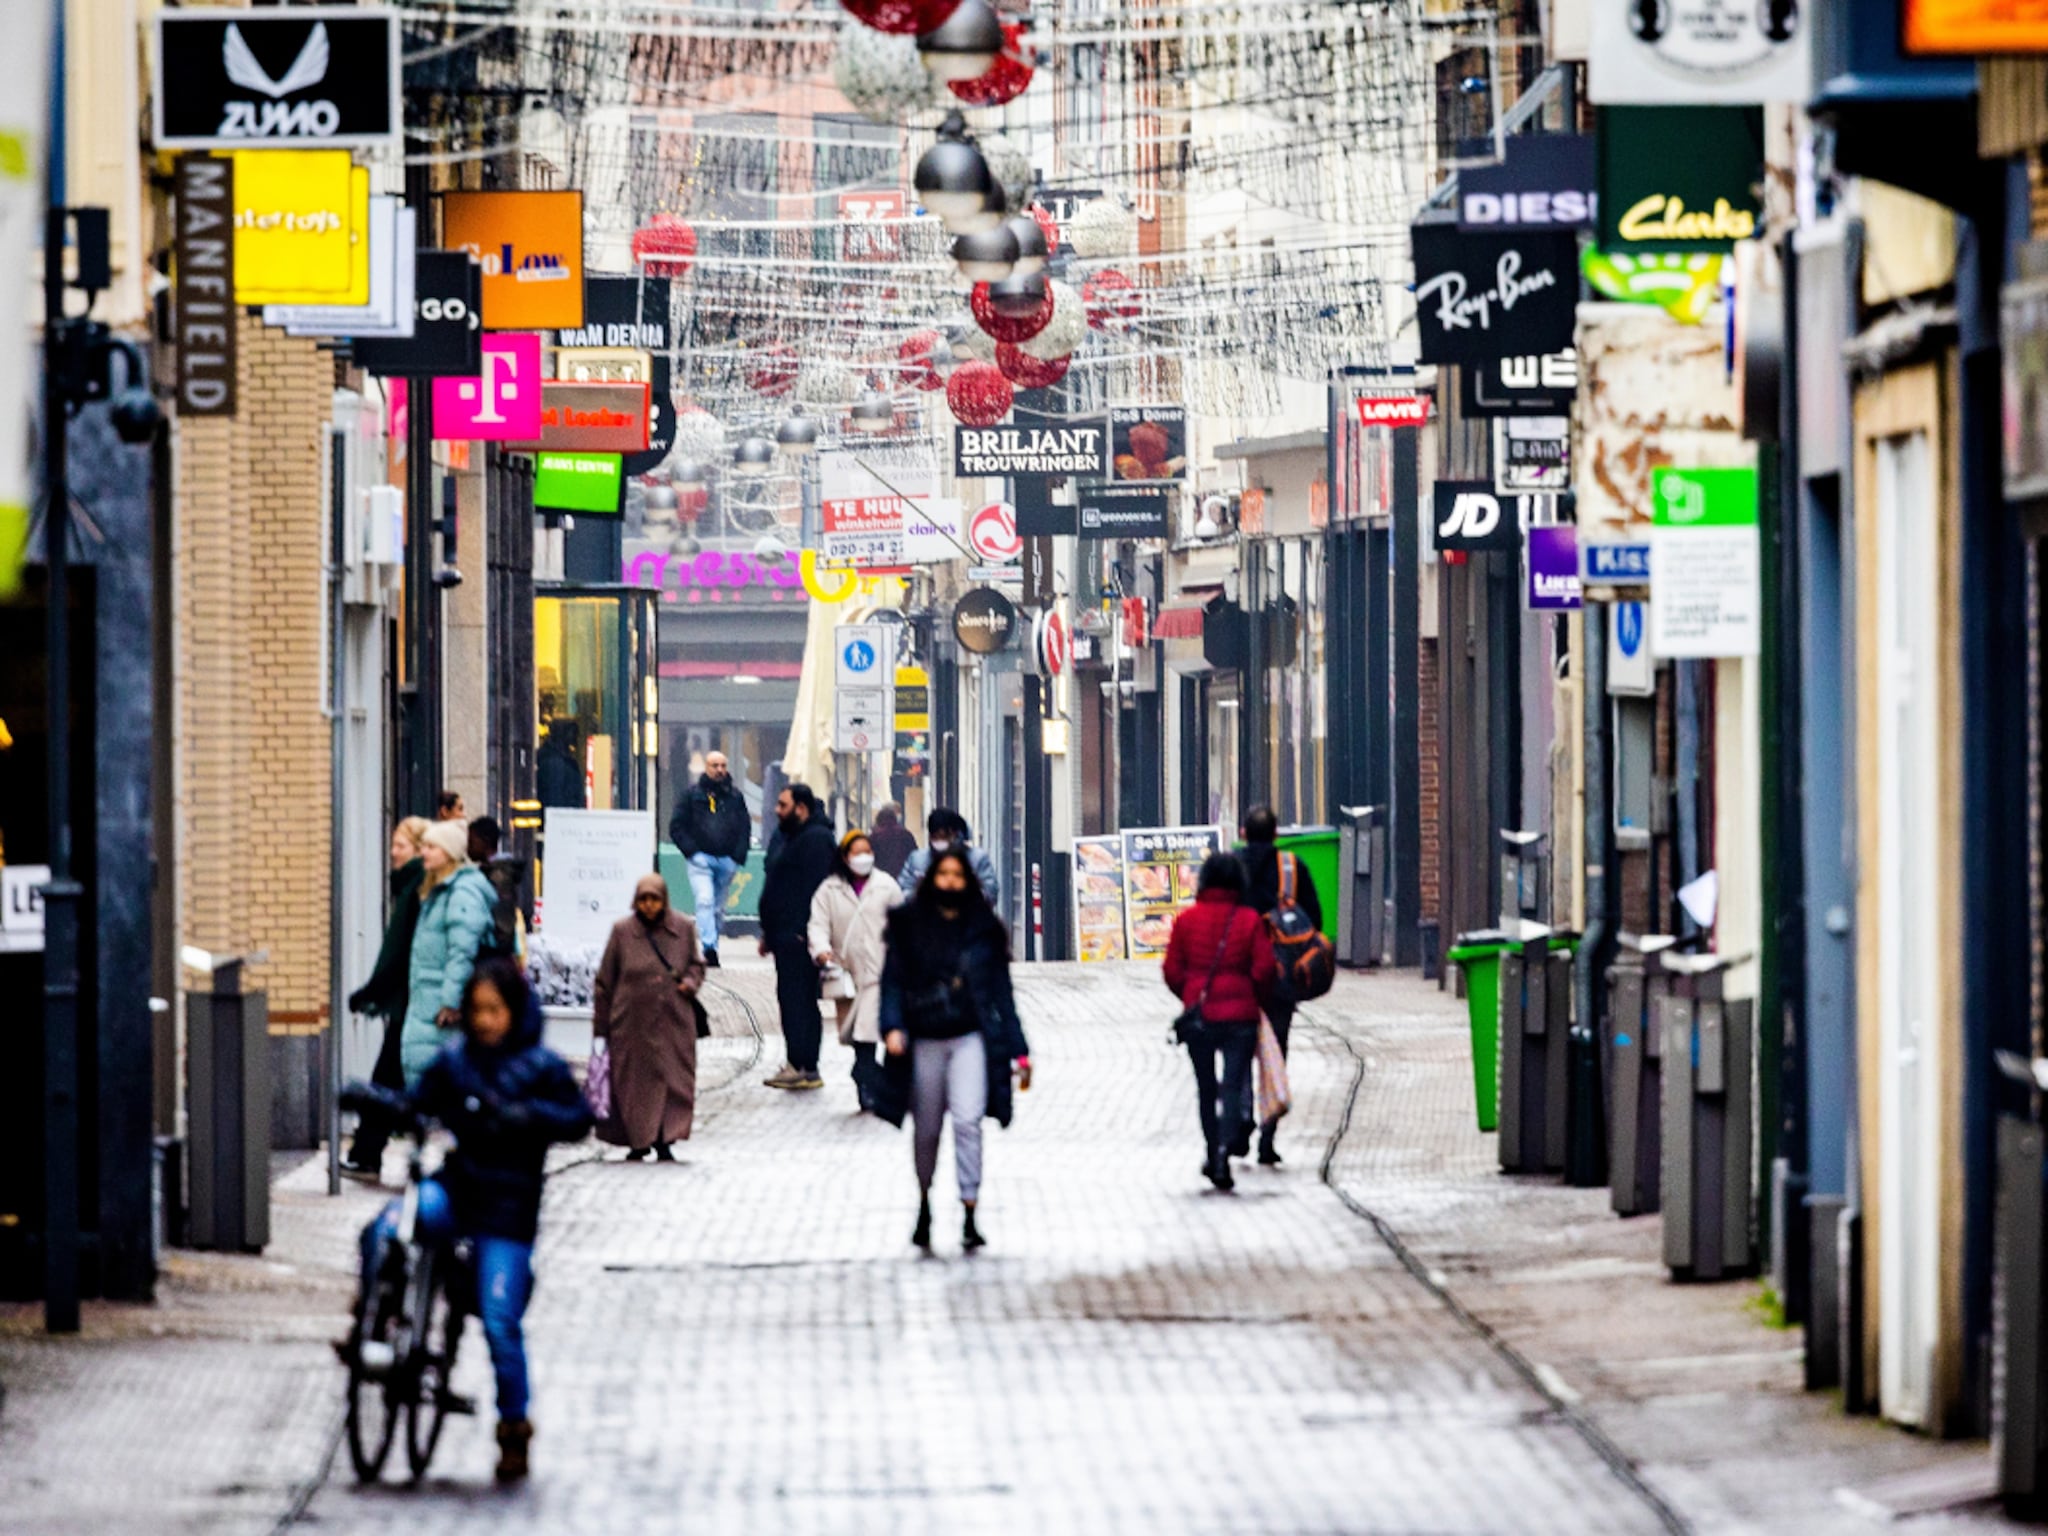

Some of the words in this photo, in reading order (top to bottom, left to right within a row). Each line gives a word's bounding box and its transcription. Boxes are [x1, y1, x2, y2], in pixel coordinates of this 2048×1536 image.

[217, 99, 340, 137] ZUMO
[232, 207, 342, 236] ntertoys
[1464, 191, 1598, 224] DIES
[1618, 193, 1754, 241] Clarks
[182, 160, 229, 410] MANFIELD
[560, 323, 604, 347] WAM
[606, 322, 664, 348] DENIM
[960, 428, 1099, 455] BRILJANT
[960, 454, 1100, 473] TROUWRINGEN
[830, 501, 856, 518] TE
[1438, 493, 1500, 538] JD
